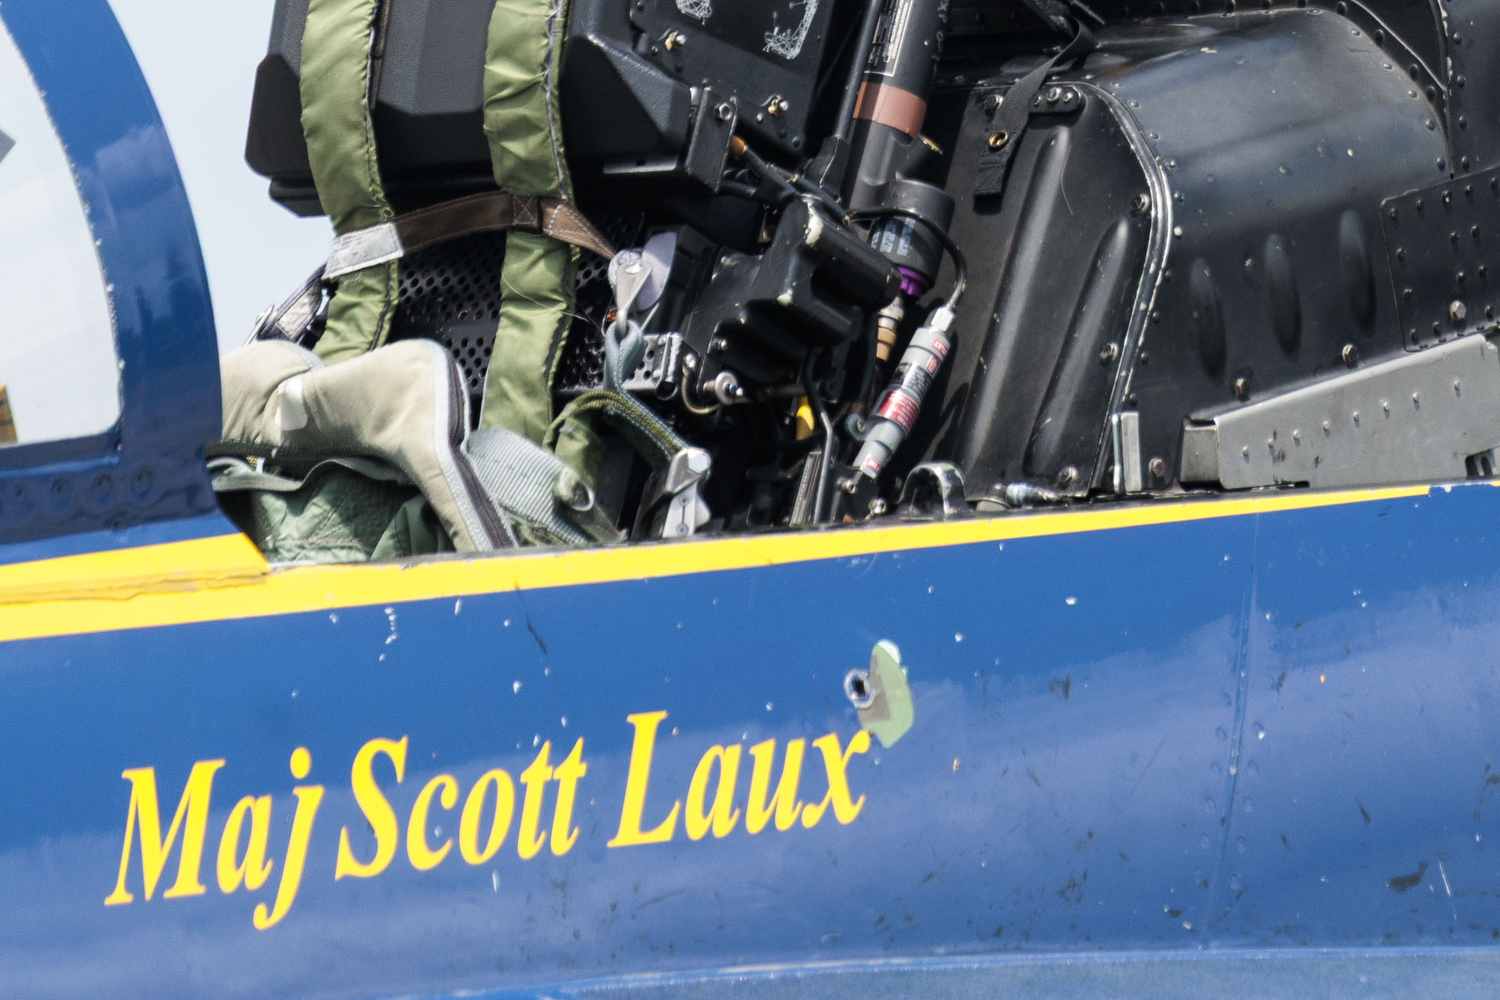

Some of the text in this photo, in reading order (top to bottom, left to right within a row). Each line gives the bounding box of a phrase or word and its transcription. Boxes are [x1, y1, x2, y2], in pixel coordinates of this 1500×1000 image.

[105, 710, 871, 930] Maj Scott Laux
